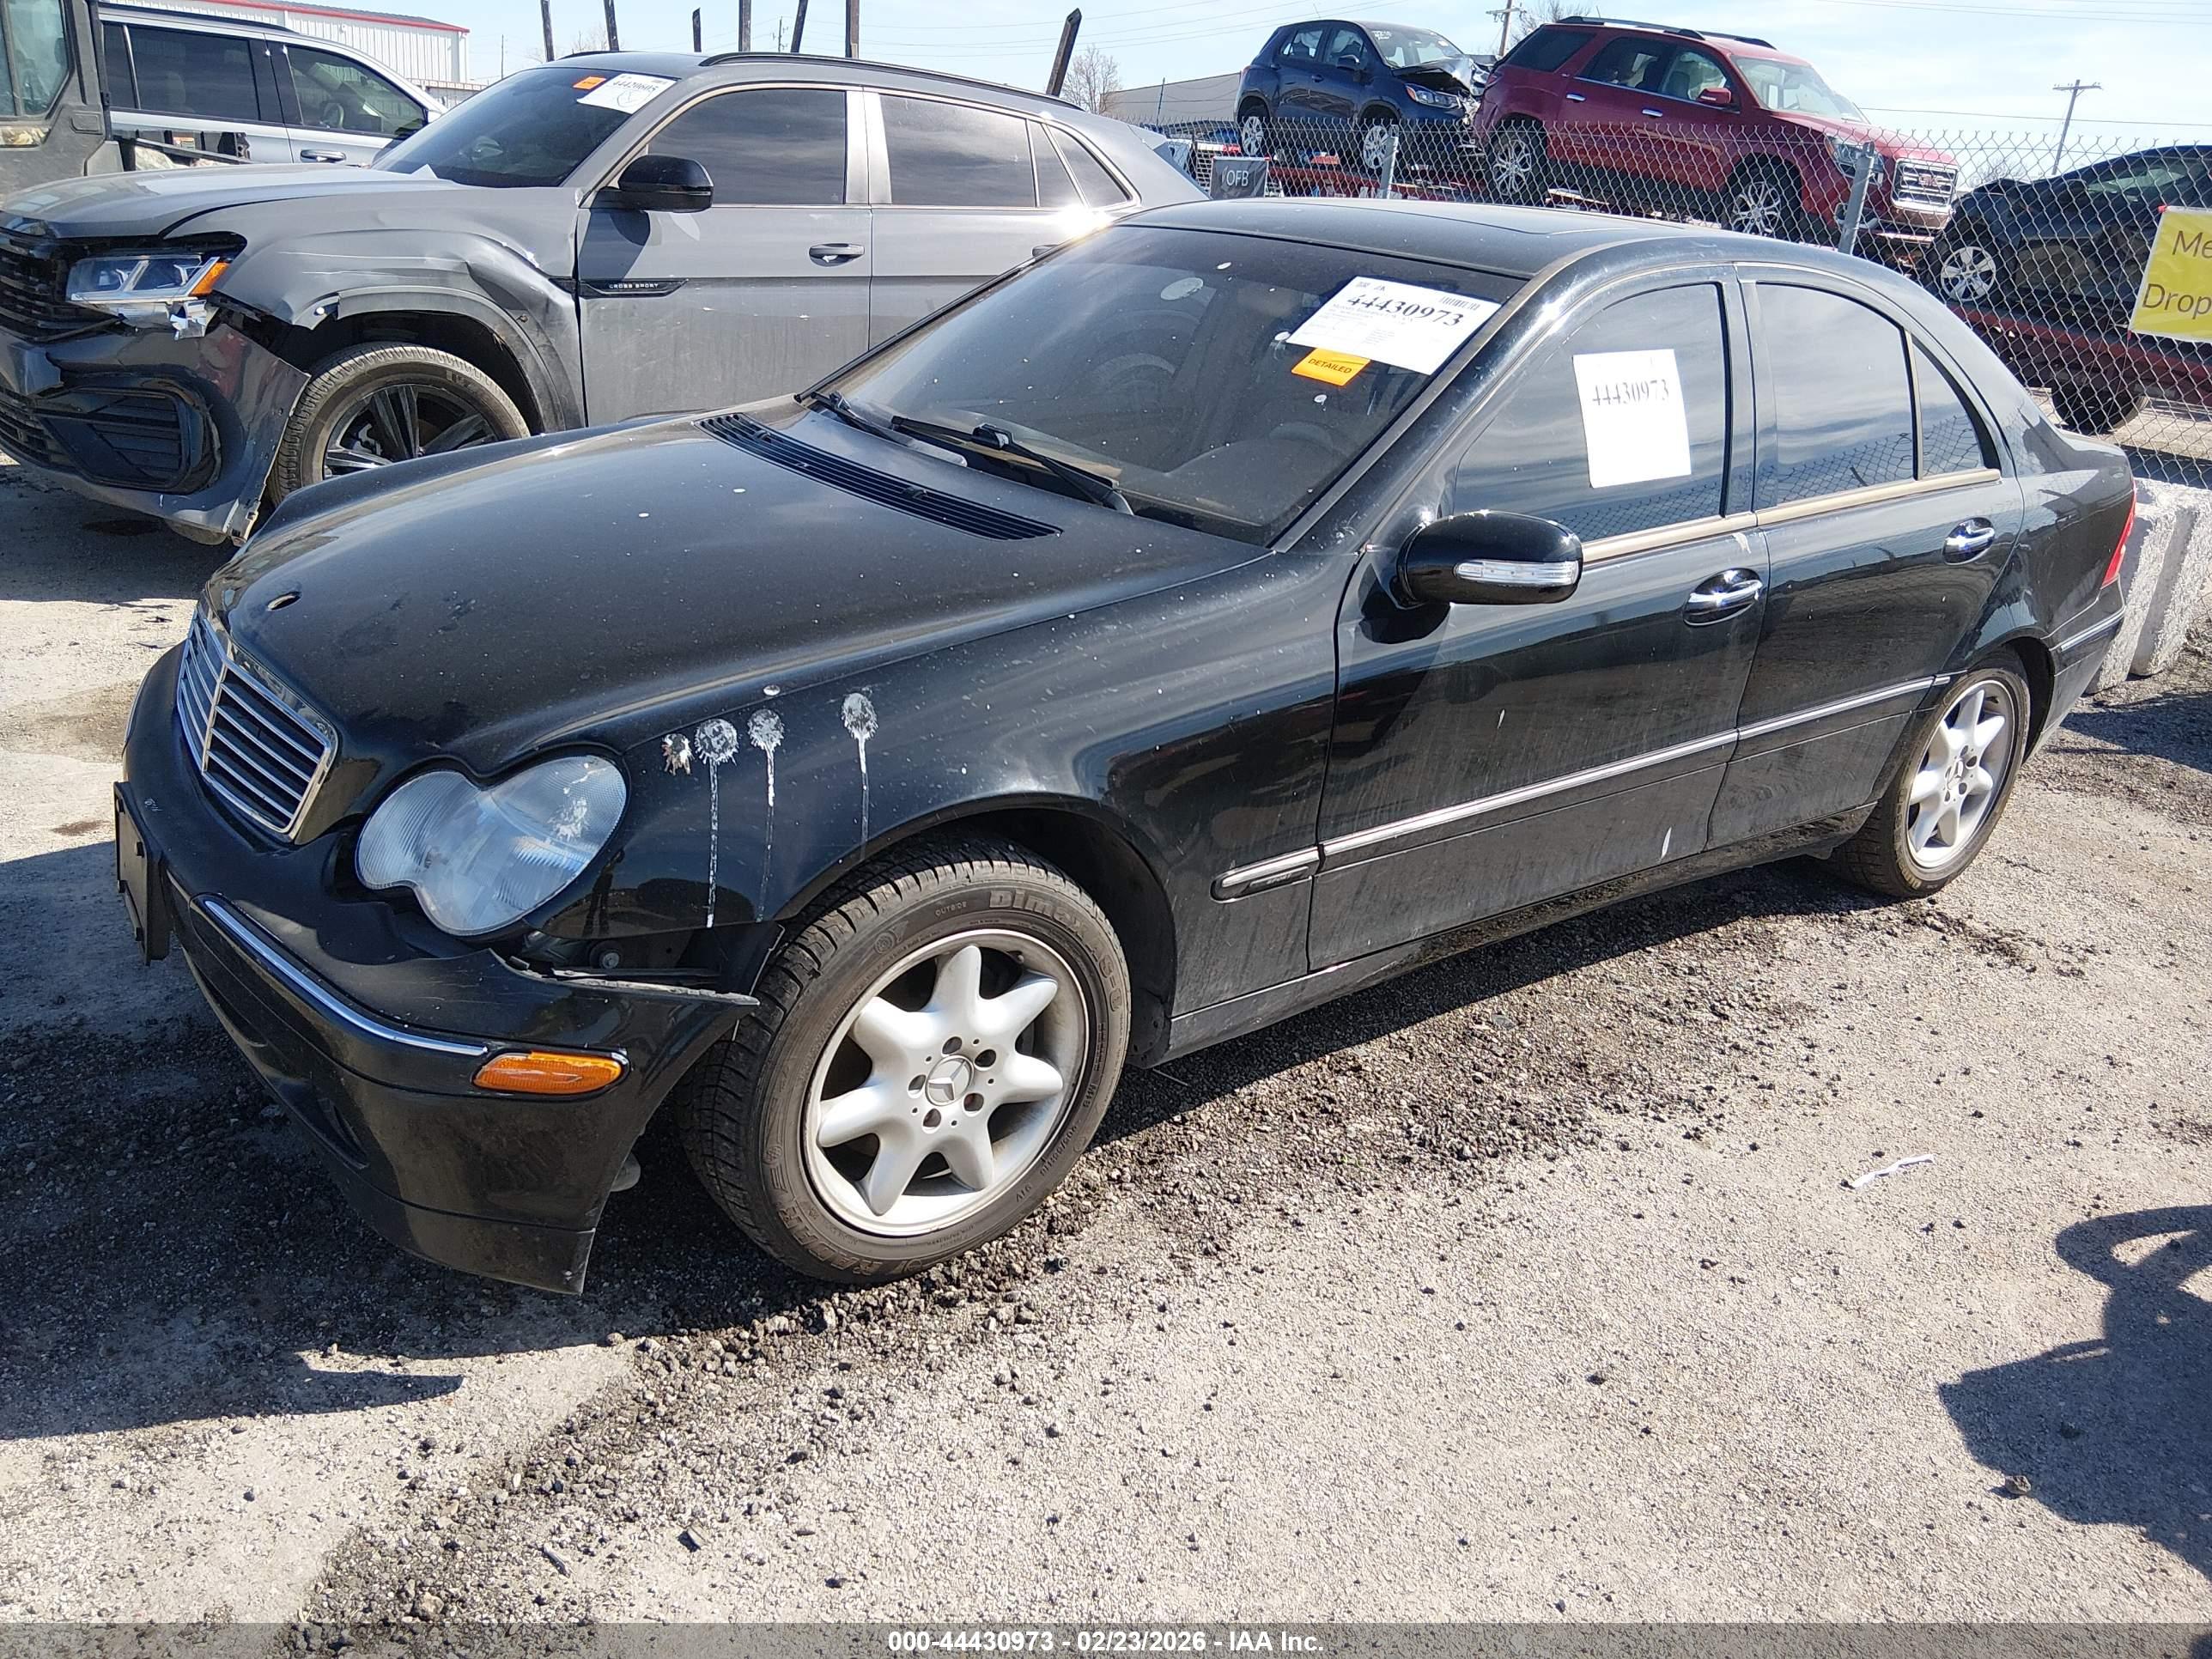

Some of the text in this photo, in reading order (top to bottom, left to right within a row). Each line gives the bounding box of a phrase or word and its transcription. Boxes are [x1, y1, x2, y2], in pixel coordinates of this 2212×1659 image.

[1346, 294, 1464, 327] 44430973
[2142, 283, 2212, 320] Drop
[1308, 358, 1352, 374] DETAILED
[1592, 378, 1670, 406] 44430973
